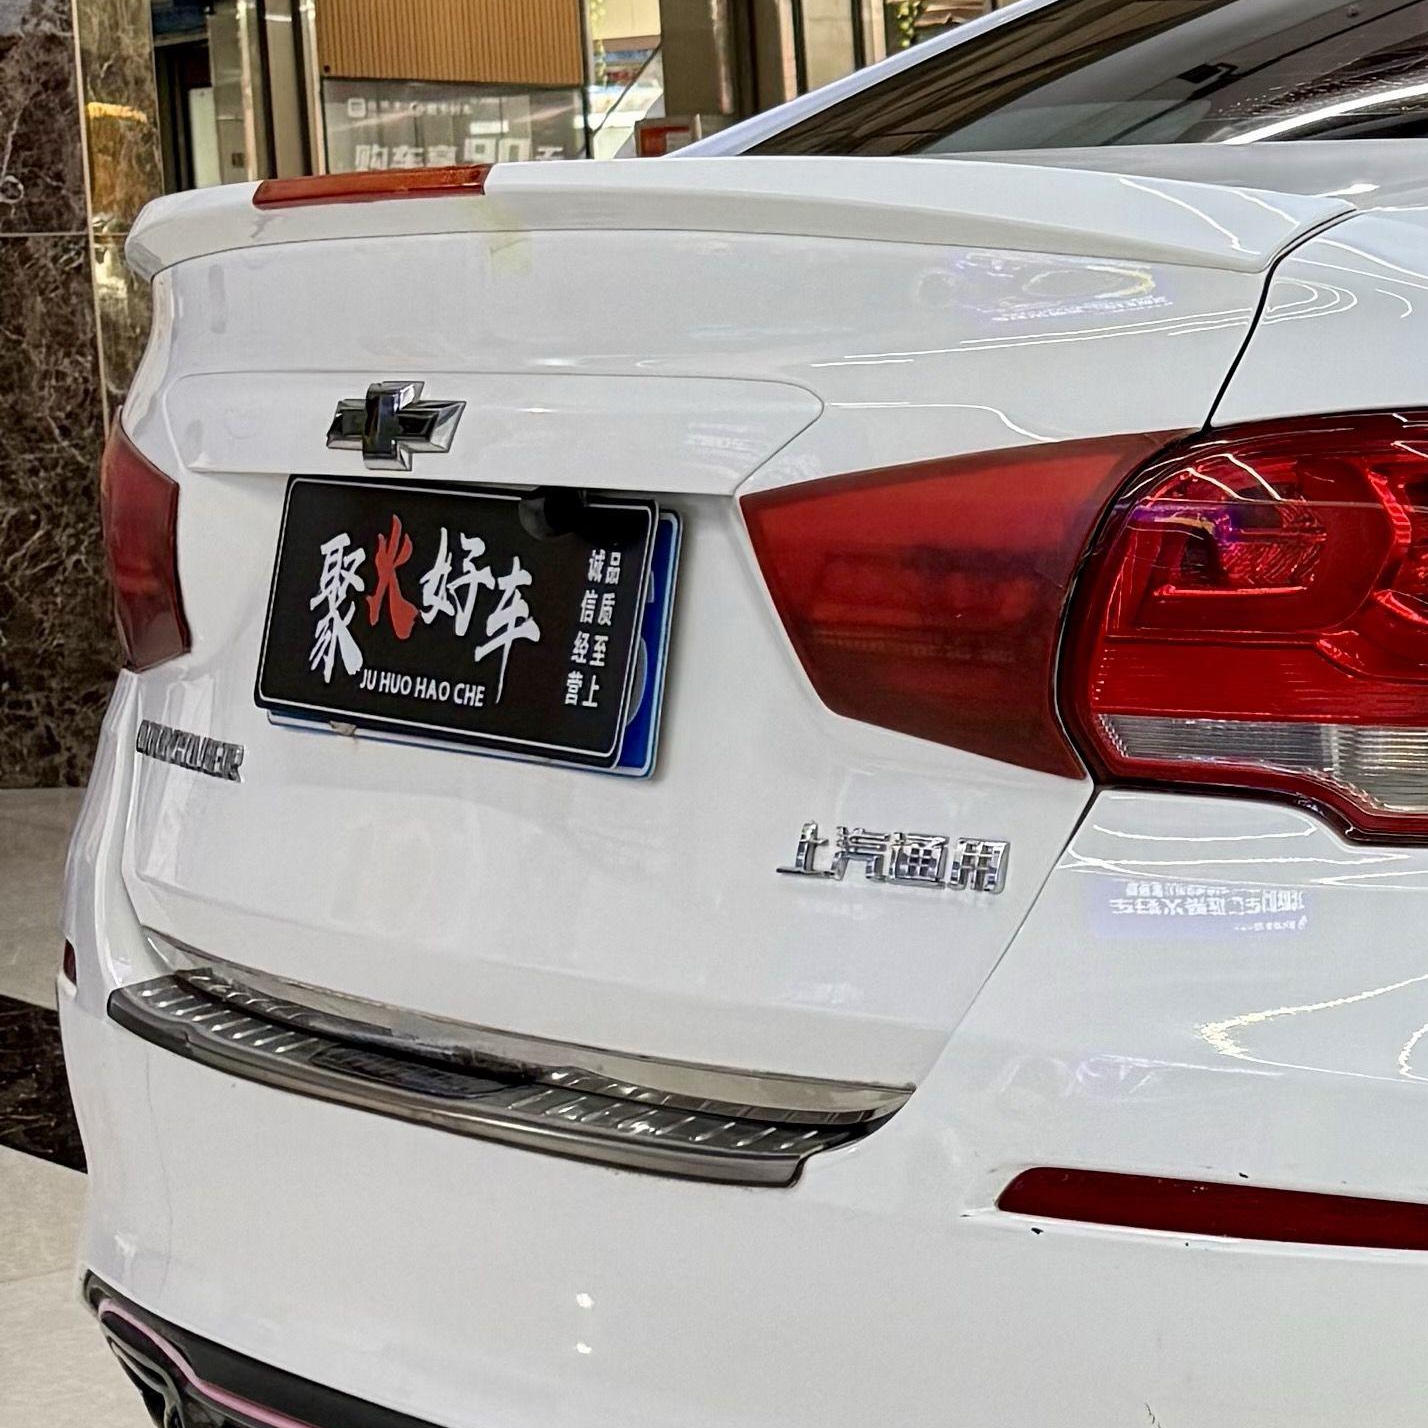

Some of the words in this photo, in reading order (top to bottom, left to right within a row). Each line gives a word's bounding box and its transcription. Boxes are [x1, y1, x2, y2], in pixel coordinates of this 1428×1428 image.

[309, 514, 540, 704] 聚火好车
[564, 548, 606, 706] 诚信经营
[582, 551, 622, 708] 品质至上
[359, 669, 378, 690] JU
[378, 673, 412, 696] HUO
[414, 678, 451, 702] HAO
[453, 682, 485, 708] CHE
